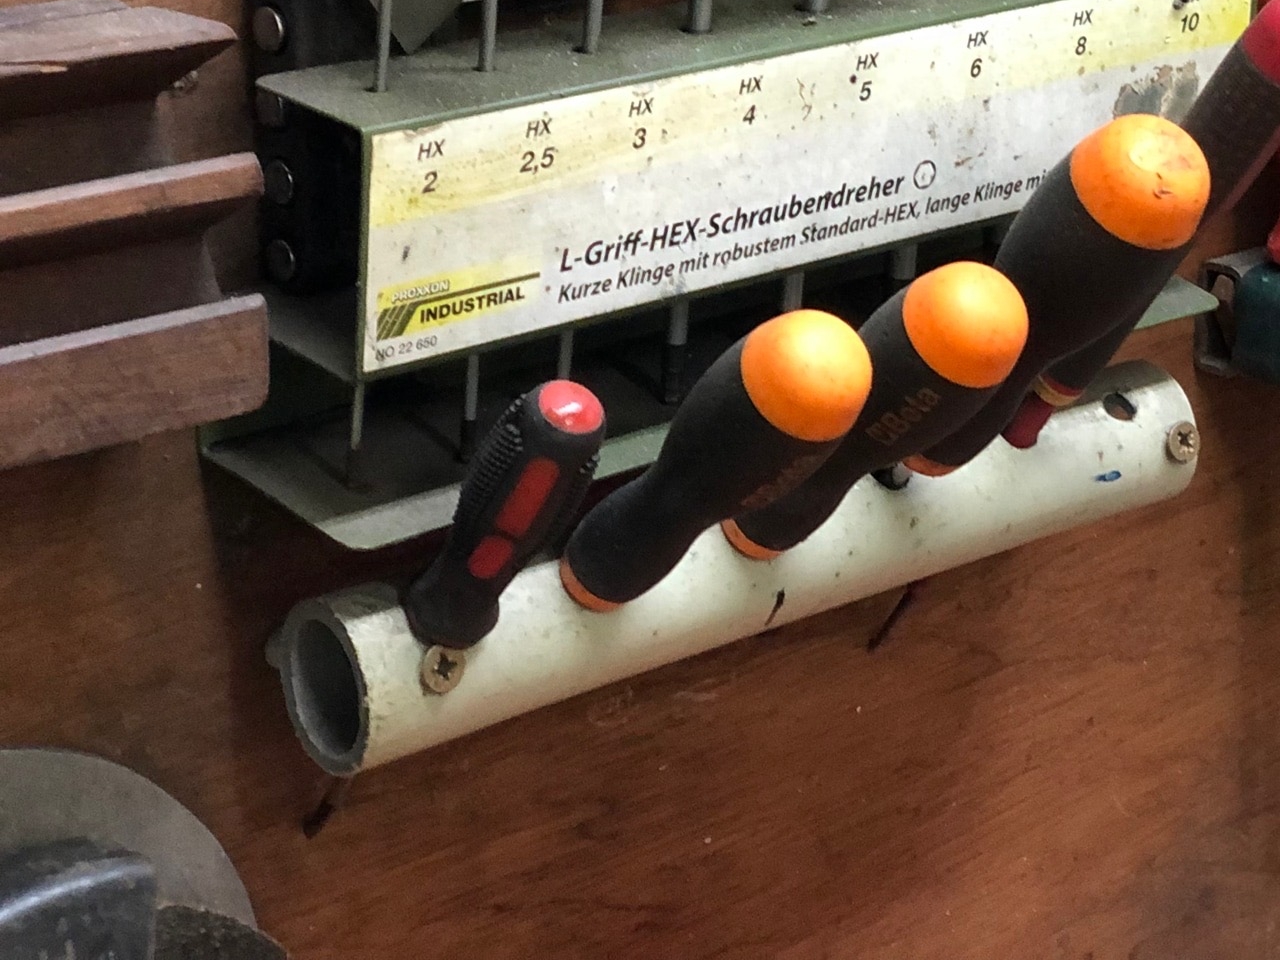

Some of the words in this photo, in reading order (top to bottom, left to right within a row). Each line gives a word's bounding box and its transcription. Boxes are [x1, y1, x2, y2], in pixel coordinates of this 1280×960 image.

[1072, 8, 1093, 27] HX
[1181, 12, 1200, 33] 10
[967, 30, 988, 49] HX
[1075, 36, 1087, 56] 8
[856, 52, 879, 72] HX
[969, 58, 982, 78] 6
[739, 76, 763, 96] HX
[858, 81, 872, 101] 5
[628, 97, 654, 118] HX
[742, 105, 756, 126] 4
[525, 118, 552, 139] HX
[632, 129, 646, 149] 3
[417, 139, 446, 161] HX
[519, 148, 555, 175] 2,5
[422, 171, 437, 195] 2
[559, 175, 905, 273] L-Griff-HEX-Schraubendreher
[557, 275, 612, 304] Kurze
[616, 260, 674, 290] Klinge
[678, 250, 710, 275] mit
[713, 232, 797, 266] robustem
[799, 200, 921, 246] Standard-HEX,
[925, 190, 970, 218] lange
[973, 180, 1023, 205] Klinge
[1026, 169, 1049, 191] mi
[391, 279, 450, 305] PROXXON
[420, 286, 526, 325] INDUSTRIAL
[375, 346, 396, 362] NO
[399, 342, 414, 355] 22
[416, 335, 438, 351] 650
